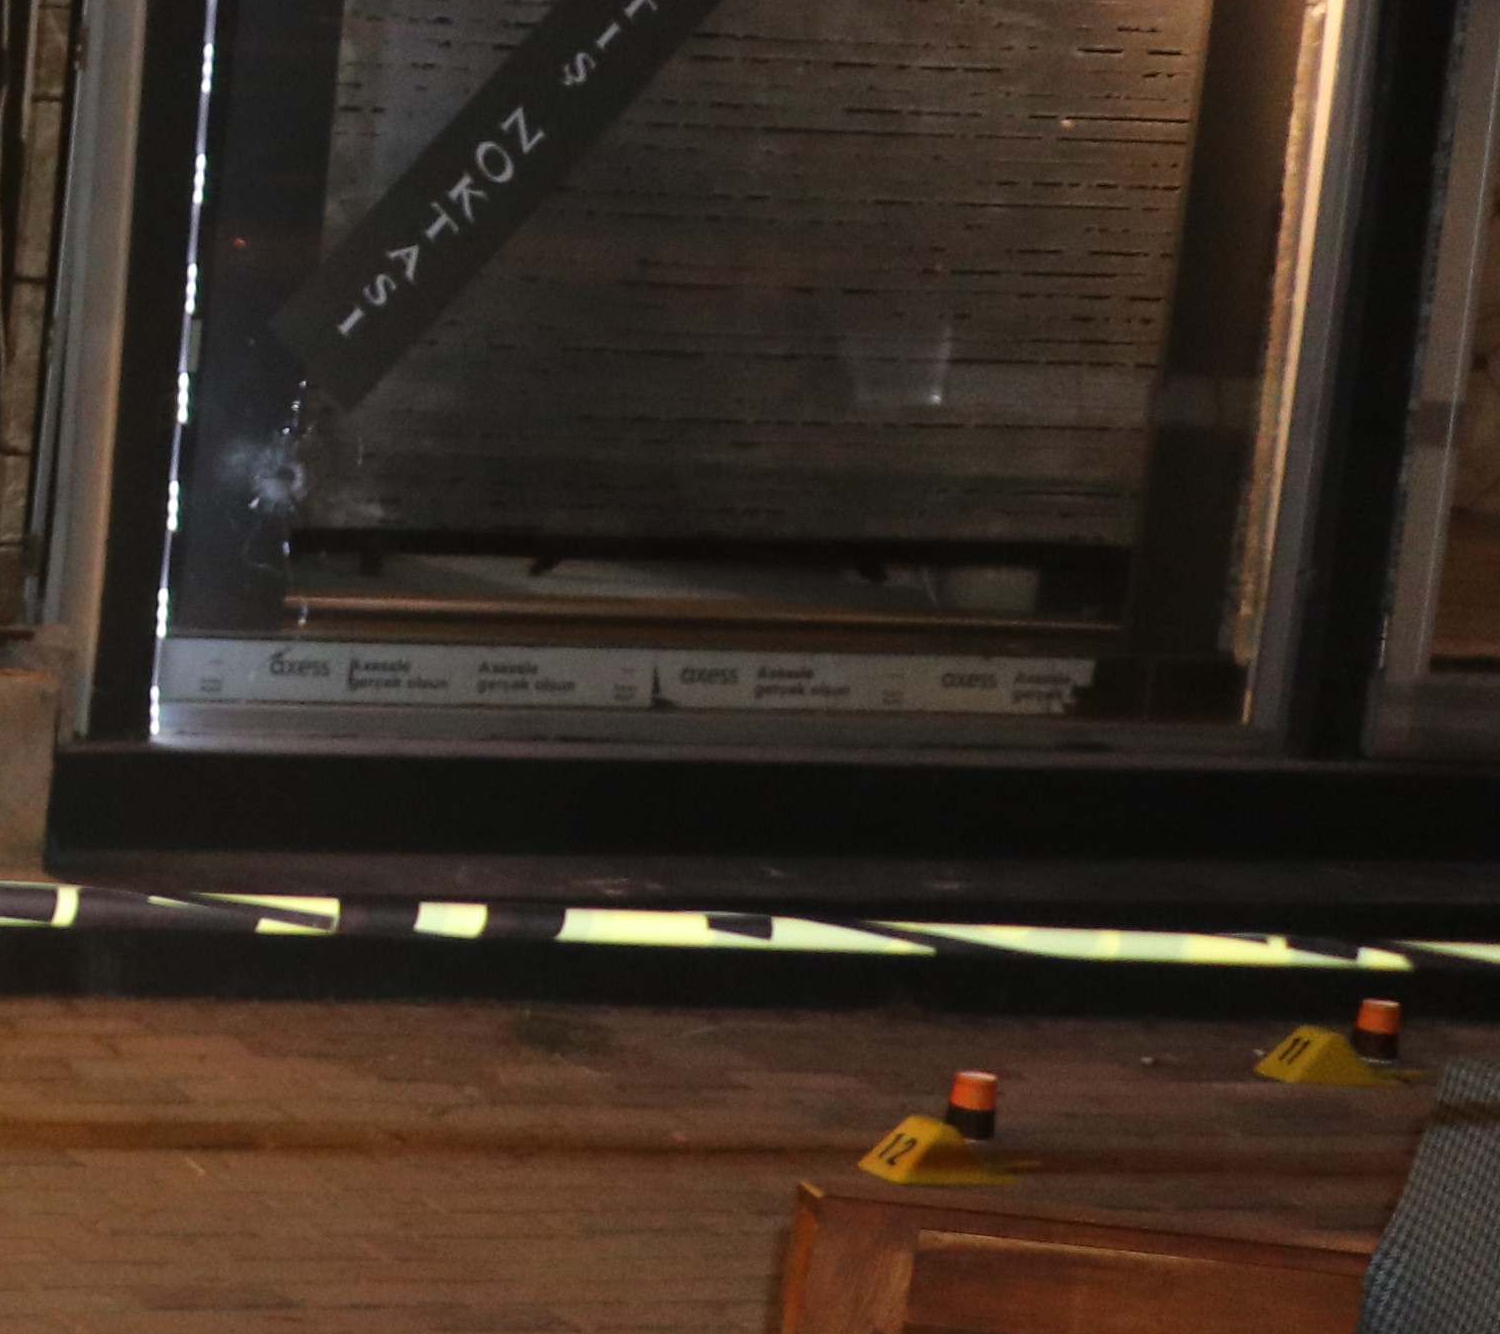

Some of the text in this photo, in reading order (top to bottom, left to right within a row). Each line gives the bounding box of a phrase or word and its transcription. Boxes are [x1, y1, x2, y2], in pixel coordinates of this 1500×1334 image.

[336, 104, 549, 341] NOKTASI
[1279, 1037, 1311, 1065] 11
[877, 1132, 917, 1167] 12
